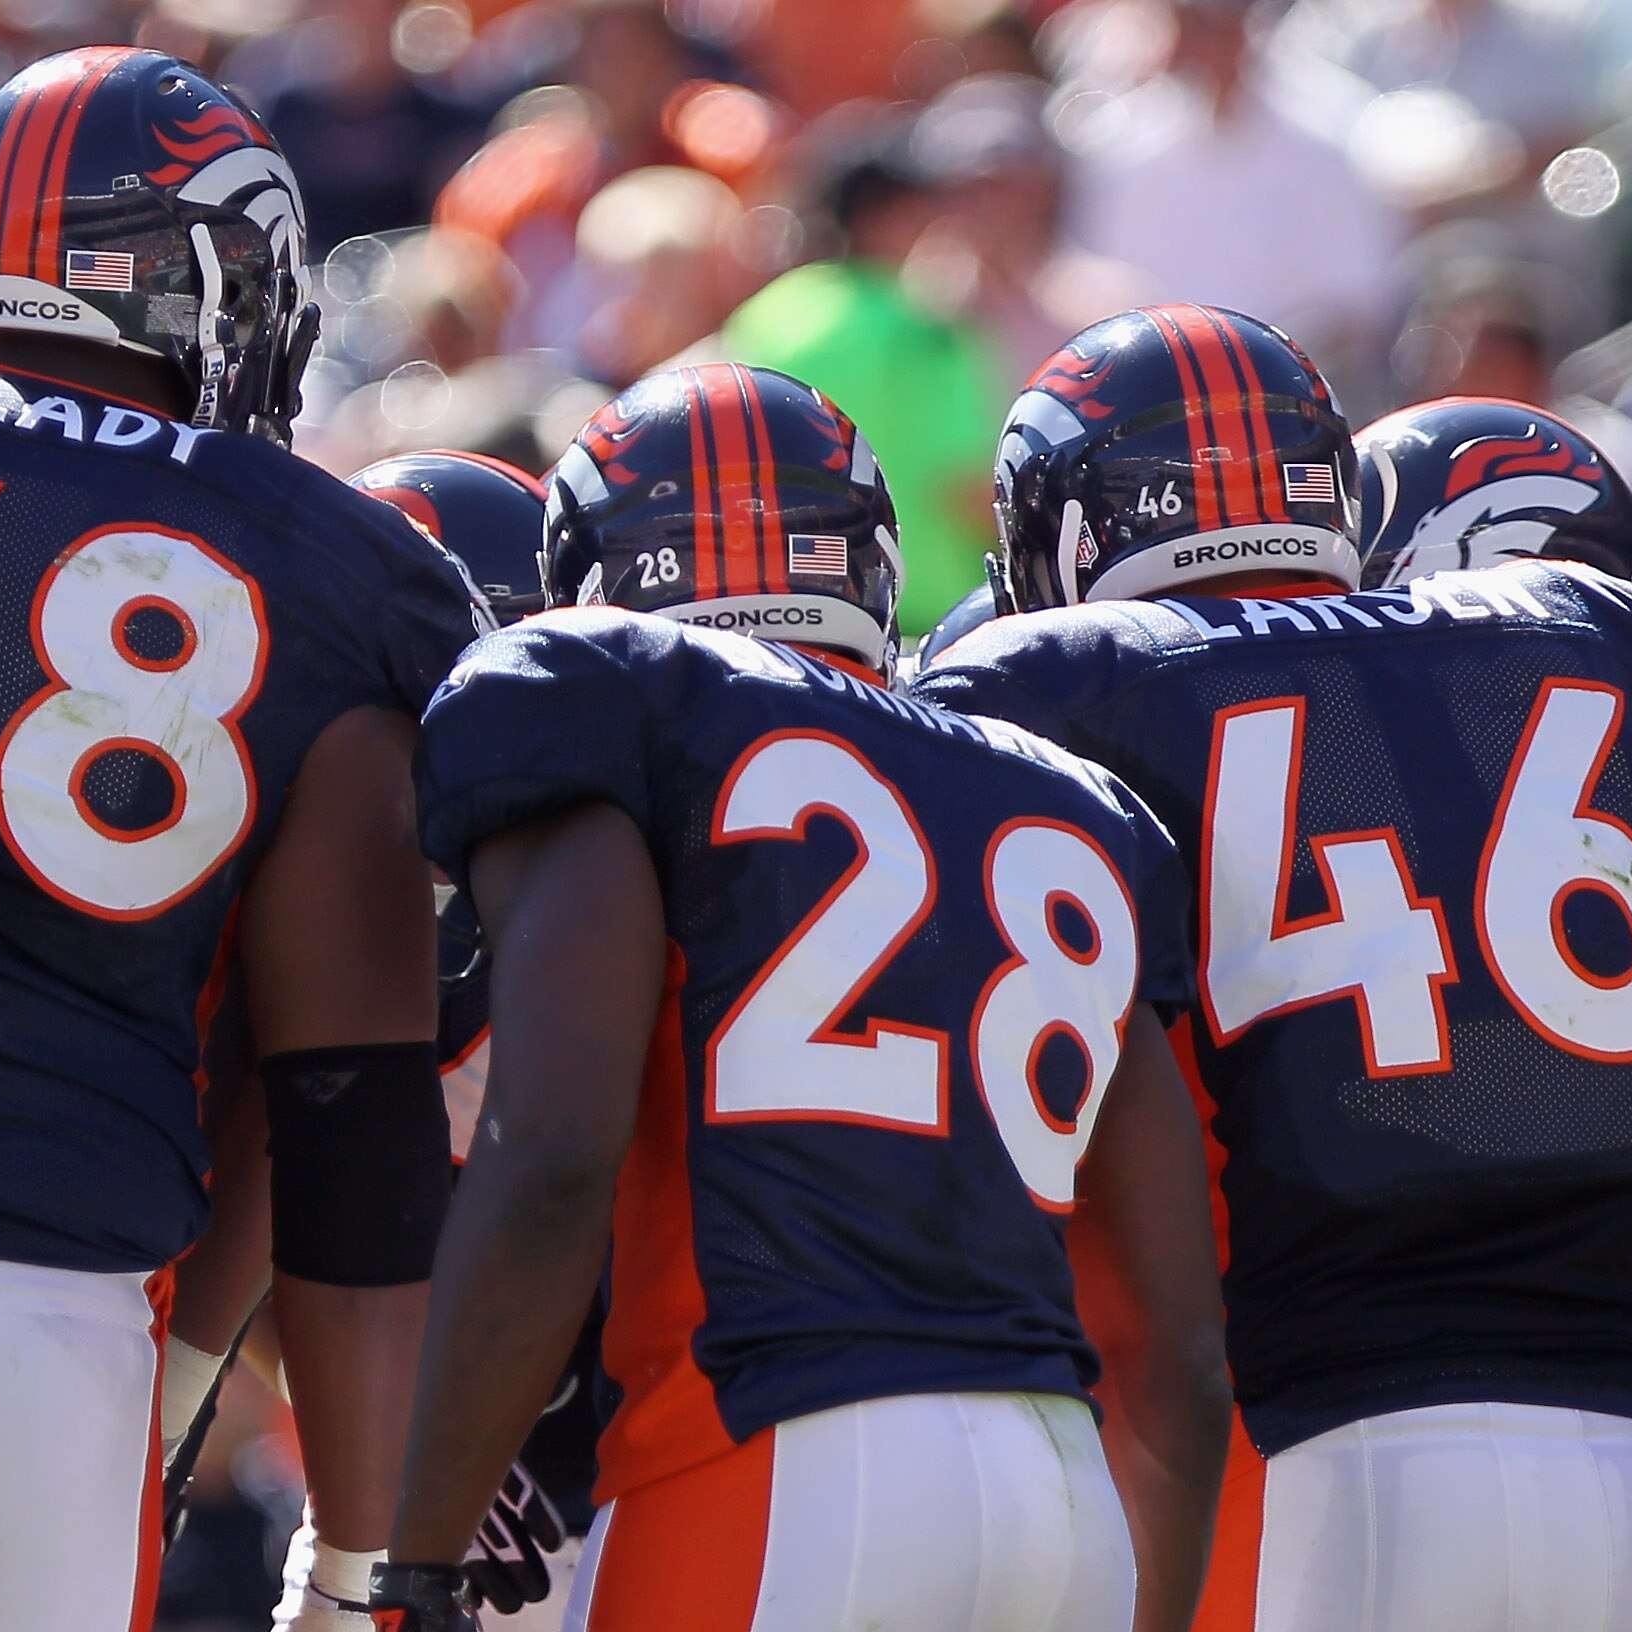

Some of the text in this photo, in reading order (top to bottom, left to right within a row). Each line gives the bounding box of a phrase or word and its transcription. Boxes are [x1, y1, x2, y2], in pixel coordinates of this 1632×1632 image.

[1136, 481, 1182, 519] 46
[635, 547, 680, 588] 28
[1173, 537, 1318, 568] BRONCOS
[1167, 573, 1553, 640] LARSEN
[704, 727, 1140, 1214] 28
